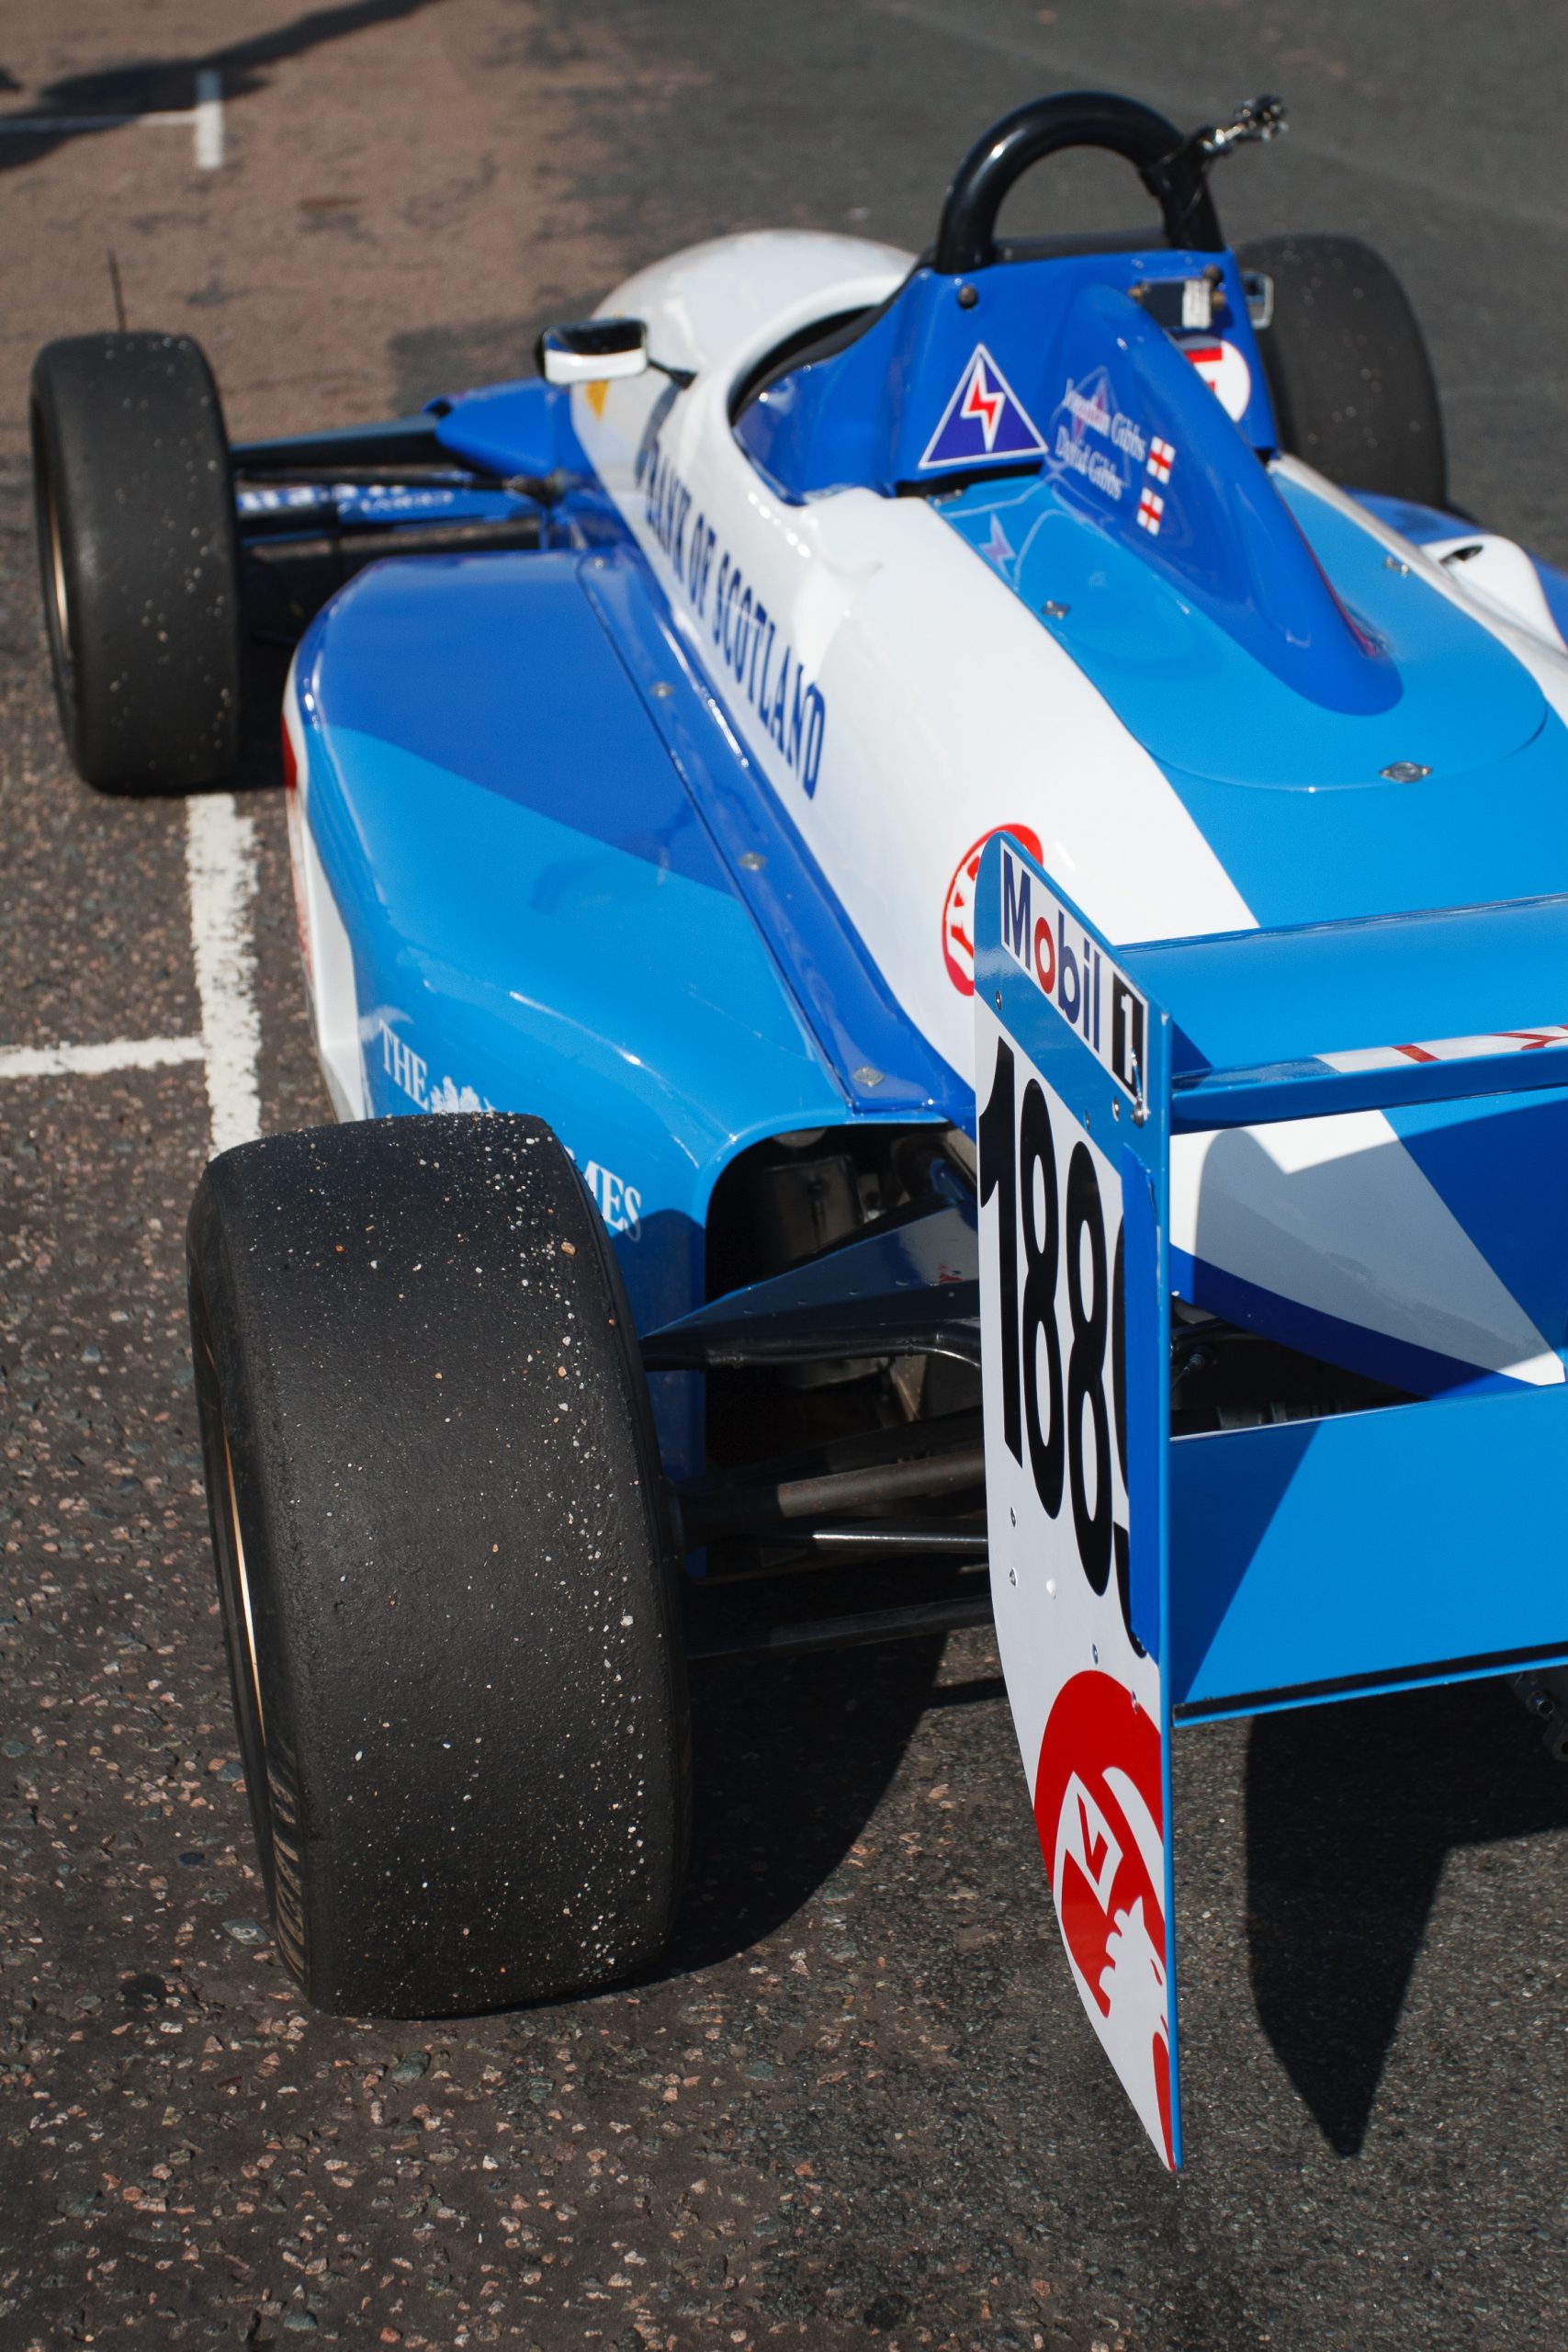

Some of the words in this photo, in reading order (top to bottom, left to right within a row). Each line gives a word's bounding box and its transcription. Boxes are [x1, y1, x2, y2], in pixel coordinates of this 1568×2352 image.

[646, 439, 693, 585] BANK
[688, 513, 716, 620] OF
[712, 553, 826, 801] SCOTLAND
[1003, 848, 1101, 1055] Mobil
[379, 1018, 429, 1113] THE
